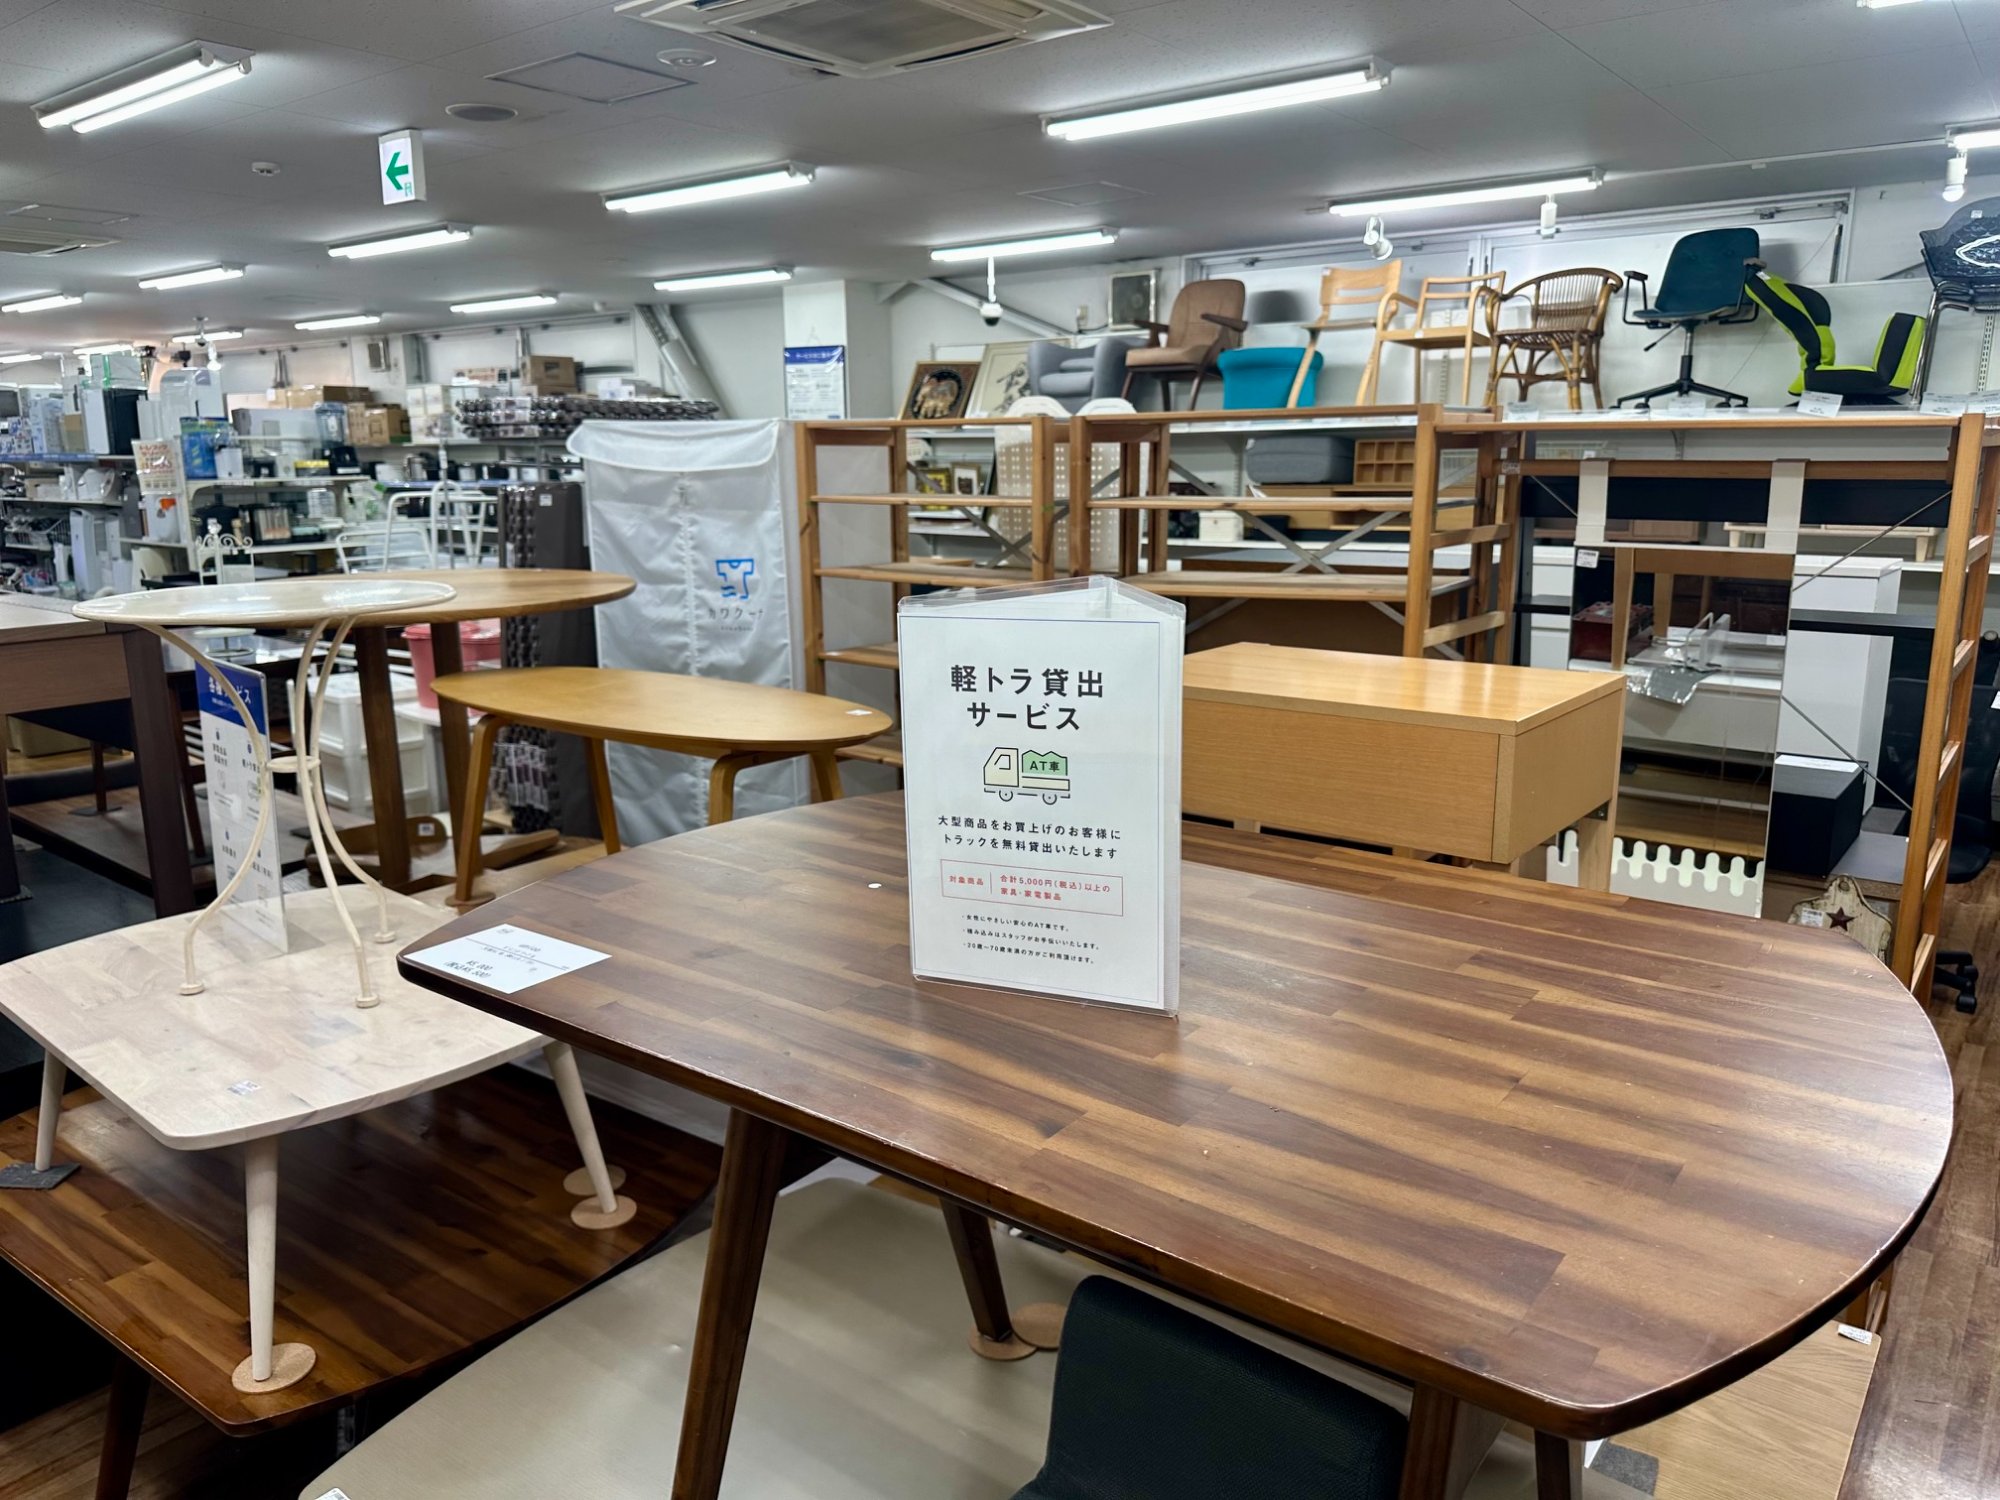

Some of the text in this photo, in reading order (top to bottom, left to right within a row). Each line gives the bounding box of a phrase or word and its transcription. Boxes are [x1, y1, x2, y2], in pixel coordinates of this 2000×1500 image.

[950, 664, 1104, 698] 軽トラ貸出
[966, 701, 1080, 731] サービス
[1029, 760, 1060, 772] AT車
[938, 814, 1121, 840] 大型商品をお買上げのお客様に
[944, 833, 1118, 860] トラックを無料貸出いたします
[949, 874, 985, 887] 対象商品
[1000, 887, 1062, 901] 家具・家電製品
